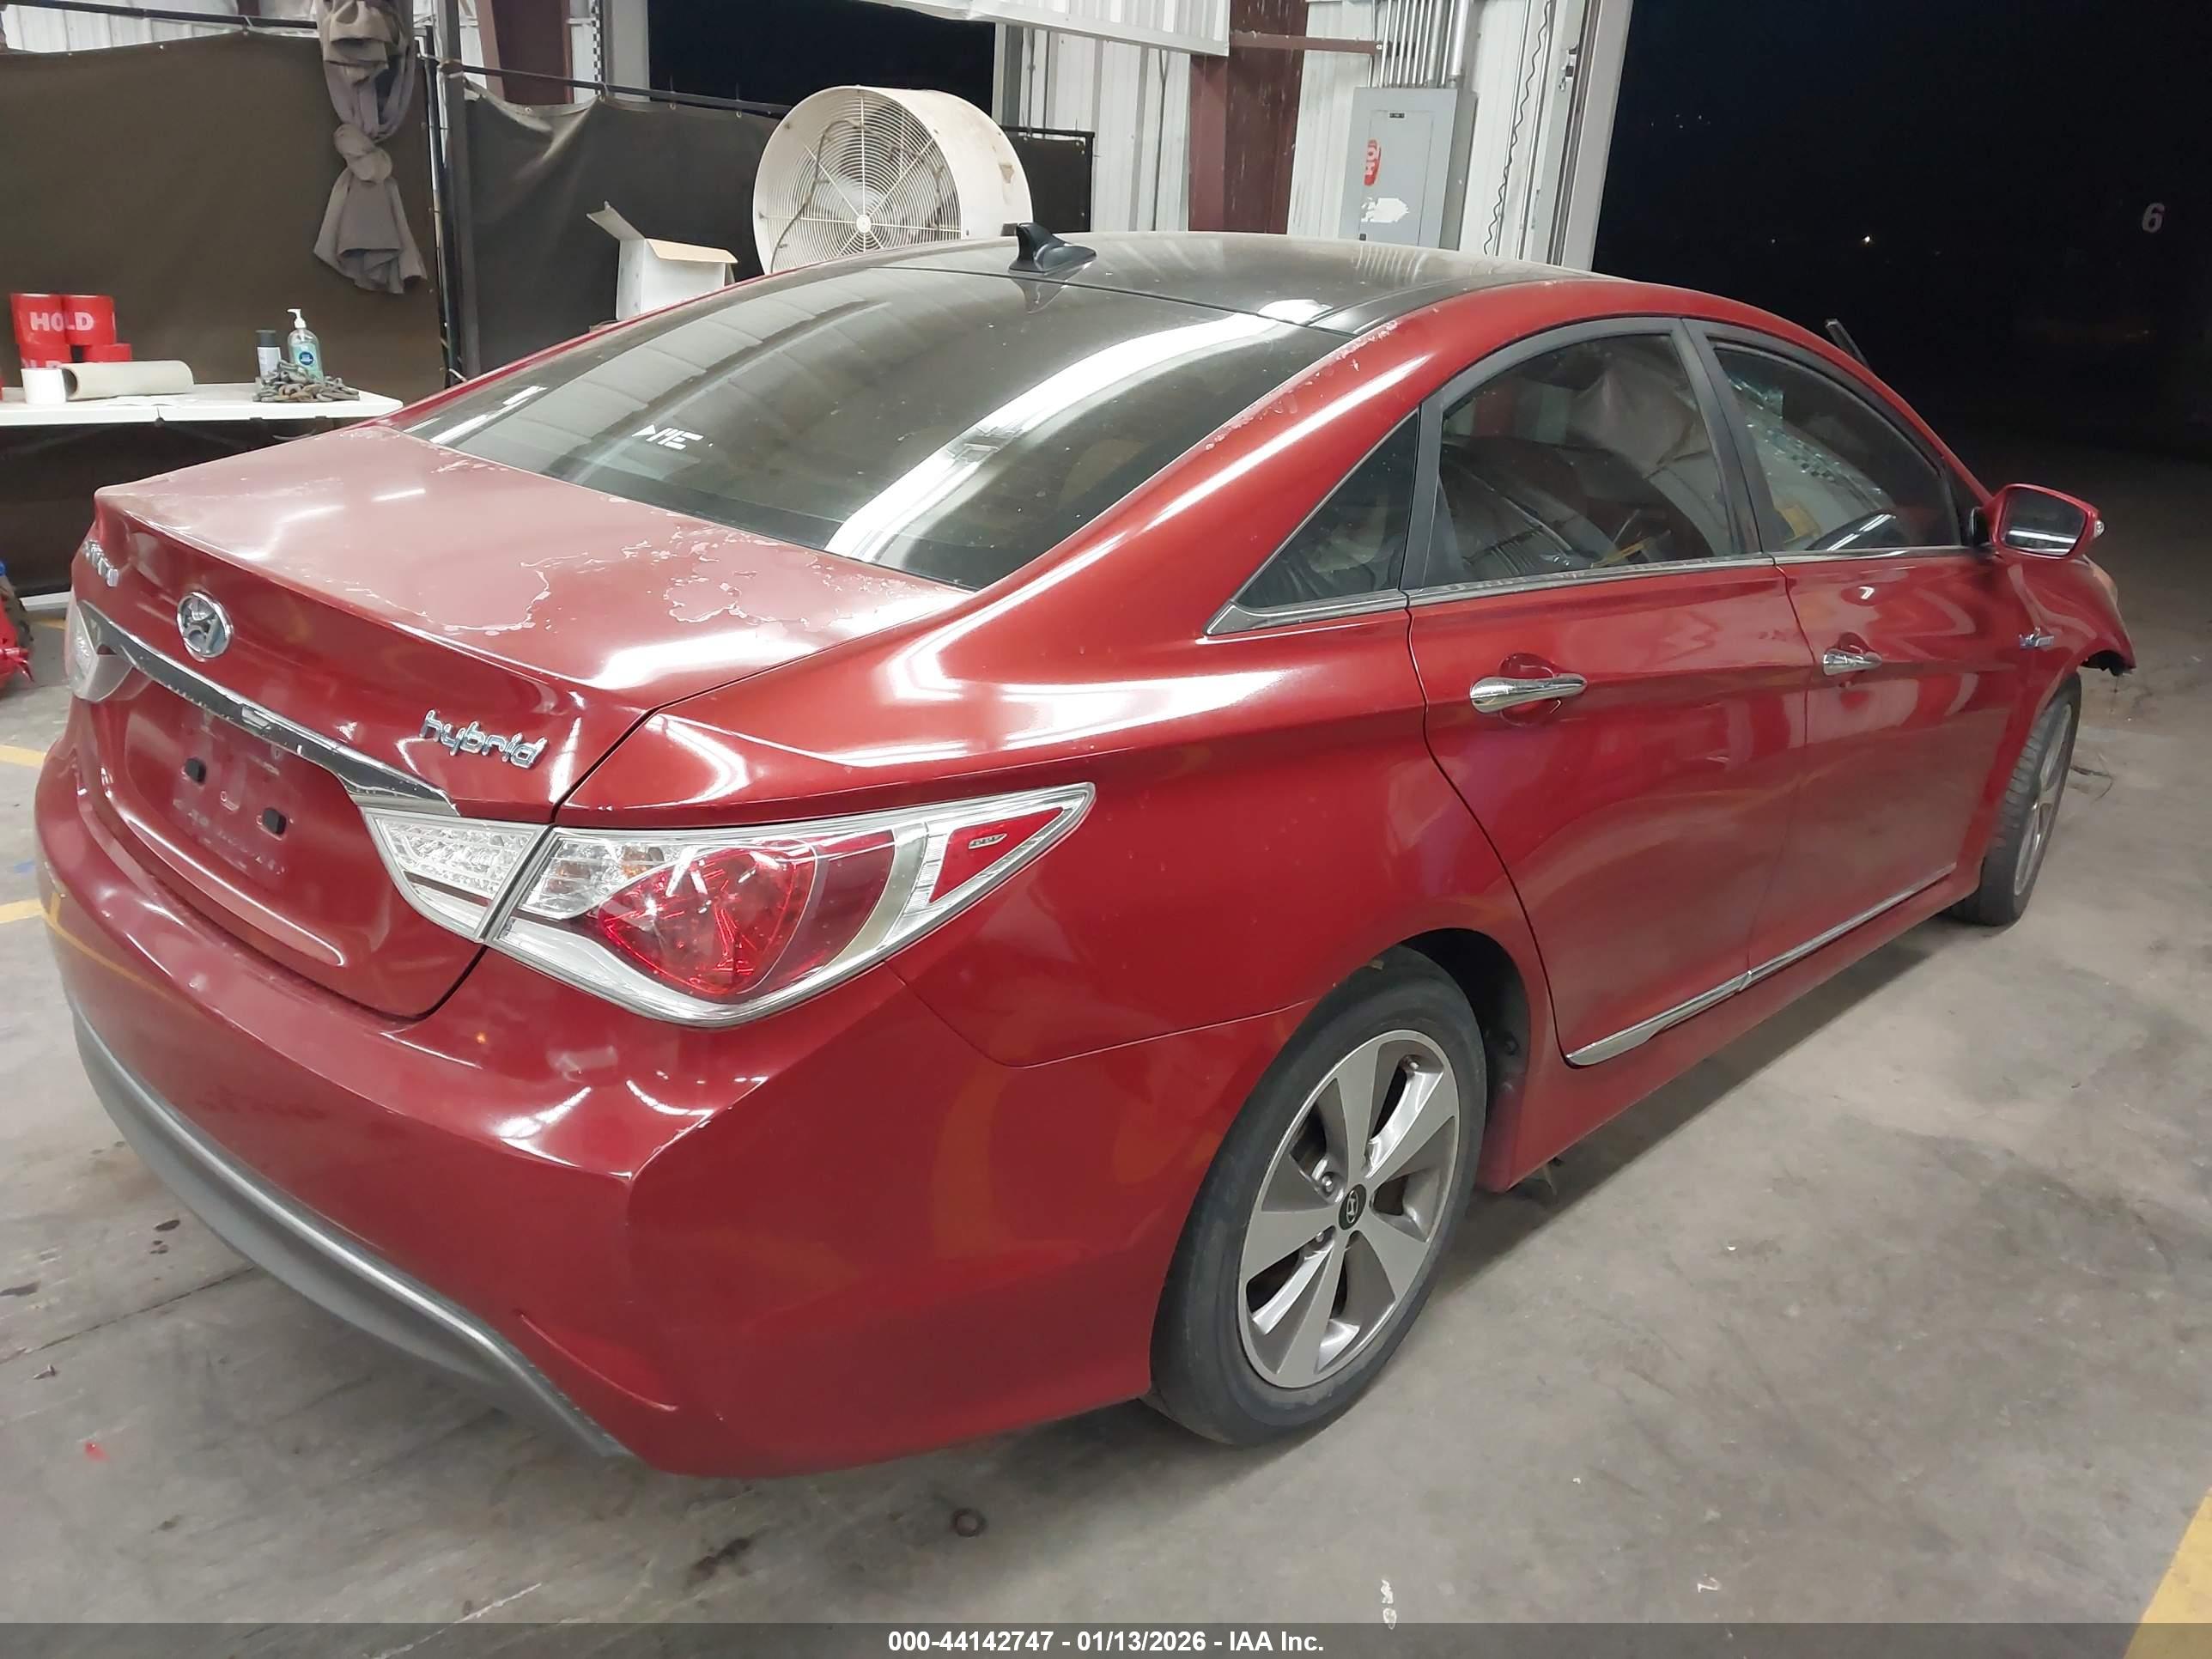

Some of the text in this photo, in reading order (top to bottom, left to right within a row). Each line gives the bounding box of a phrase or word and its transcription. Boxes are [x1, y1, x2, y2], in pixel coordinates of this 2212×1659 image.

[2142, 203, 2165, 233] 6
[29, 312, 94, 331] HOLD
[419, 709, 548, 769] hybrid
